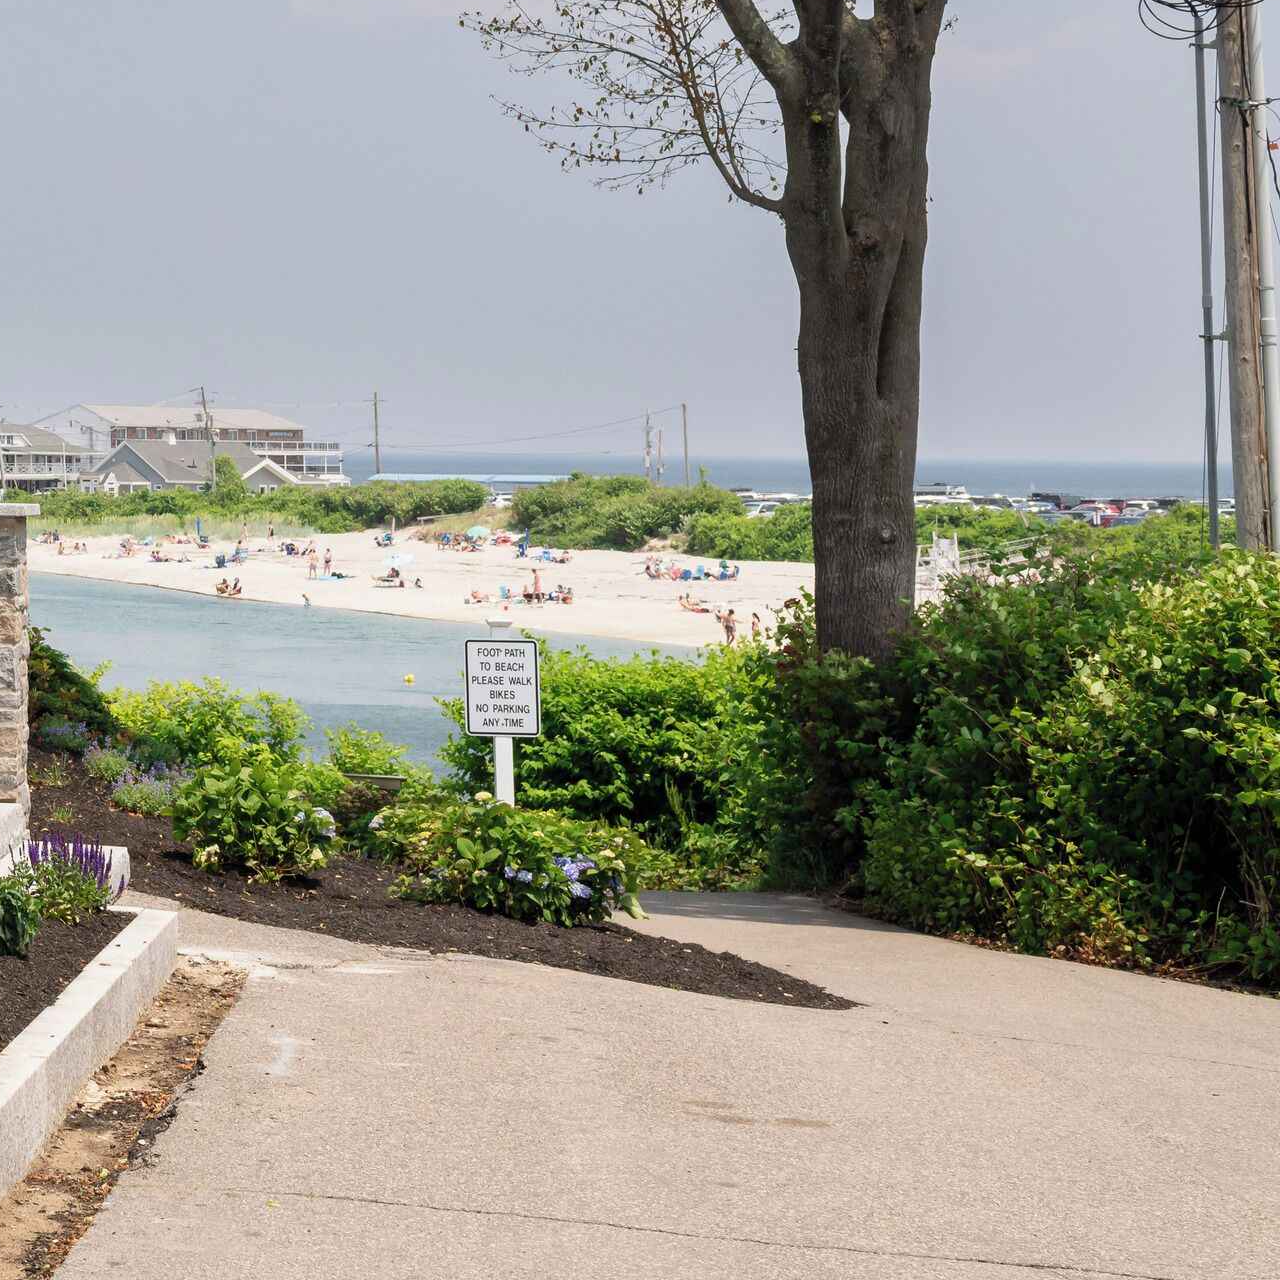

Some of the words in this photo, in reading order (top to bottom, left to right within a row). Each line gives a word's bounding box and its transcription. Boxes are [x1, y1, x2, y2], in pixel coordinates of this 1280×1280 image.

[477, 648, 500, 657] FOOT
[504, 648, 525, 658] PATH
[480, 662, 491, 671] TO
[495, 662, 524, 672] BEACH
[471, 676, 505, 686] PLEASE
[508, 677, 532, 686] WALK
[489, 690, 515, 700] BIKES
[475, 703, 489, 713] NO
[492, 704, 530, 714] PARKING
[482, 718, 499, 727] ANY
[504, 718, 524, 727] TIME
